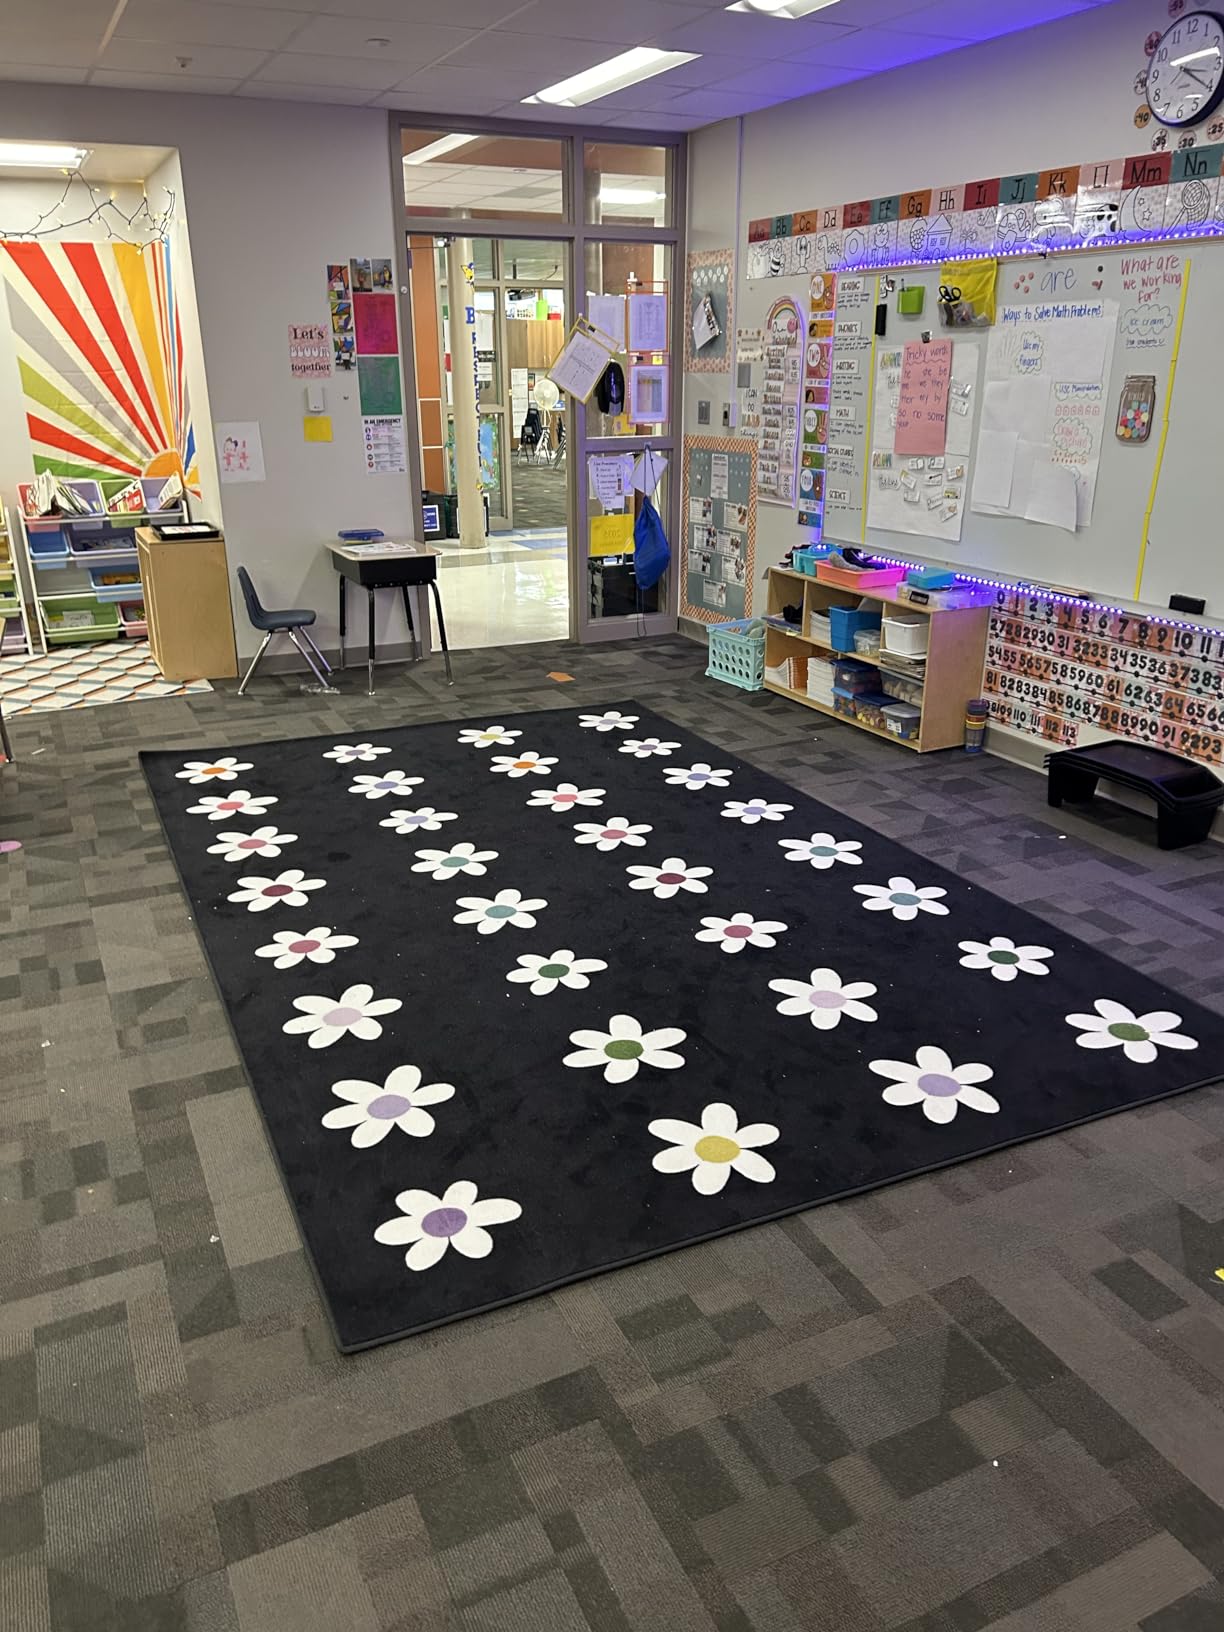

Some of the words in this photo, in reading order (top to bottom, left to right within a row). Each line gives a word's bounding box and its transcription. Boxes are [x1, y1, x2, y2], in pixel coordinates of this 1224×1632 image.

[1187, 18, 1199, 34] 12
[1203, 22, 1209, 37] 1
[1171, 30, 1182, 45] 11
[1213, 35, 1220, 48] 2
[1156, 47, 1168, 63] 10
[1214, 57, 1222, 71] 3
[1151, 69, 1159, 84] 9
[1206, 78, 1214, 92] 4
[1153, 88, 1161, 102] 8
[1162, 102, 1170, 117] 7
[1176, 104, 1183, 118] 6
[1191, 97, 1199, 111] 5
[1131, 161, 1162, 183] Mm
[1184, 152, 1208, 176] Nn
[1011, 179, 1026, 203] Jj
[1048, 172, 1067, 195] Kk
[938, 190, 955, 211] Hh
[975, 185, 986, 205] Ii
[879, 200, 892, 220] Ff
[907, 196, 923, 217] Gg
[799, 216, 810, 231] Cc
[823, 210, 836, 228] Dd
[850, 210, 862, 225] Ee
[776, 221, 787, 235] Bb
[1121, 257, 1153, 275] What
[1158, 254, 1179, 269] are
[1040, 268, 1076, 294] are
[1123, 279, 1137, 290] we
[1141, 272, 1182, 290] working
[1138, 288, 1160, 303] for?
[1002, 307, 1021, 326] Ways
[1024, 307, 1032, 320] to
[1034, 305, 1051, 321] Solve
[1052, 304, 1070, 318] Math
[293, 327, 325, 341] Let's
[906, 347, 928, 362] Tricky
[291, 361, 331, 373] together
[836, 408, 850, 418] MATH
[997, 589, 1005, 604] 0
[1014, 593, 1019, 610] 1
[1029, 597, 1038, 612] 2
[1045, 601, 1054, 617] 3
[1063, 604, 1073, 622] 4
[1081, 608, 1090, 625] 5
[1098, 612, 1108, 629] 6
[1119, 618, 1129, 634] 7
[1139, 622, 1149, 640] 8
[1157, 627, 1168, 643] 9
[1174, 630, 1193, 650] 10
[1200, 636, 1212, 655] 11
[991, 618, 1006, 632] 27
[1006, 621, 1022, 637] 28
[1023, 625, 1038, 641] 29
[1038, 629, 1055, 645] 30
[1057, 634, 1070, 650] 31
[1073, 638, 1091, 656] 32
[1091, 642, 1109, 660] 33
[1110, 647, 1128, 665] 34
[1130, 652, 1148, 669] 35
[1148, 657, 1167, 675] 36
[1169, 663, 1190, 681] 37
[1190, 668, 1213, 688] 38
[988, 645, 1002, 660] 54
[1003, 650, 1017, 664] 55
[1019, 654, 1034, 670] 56
[1035, 657, 1052, 674] 57
[1052, 661, 1068, 679] 58
[1069, 666, 1085, 683] 59
[1086, 671, 1104, 688] 60
[1107, 678, 1120, 694] 61
[1124, 682, 1143, 700] 62
[1144, 689, 1163, 707] 63
[1165, 696, 1184, 714] 64
[1186, 701, 1206, 719] 65
[986, 671, 997, 686] 81
[1000, 675, 1015, 691] 82
[1016, 679, 1031, 696] 83
[1032, 684, 1047, 702] 84
[1049, 689, 1064, 706] 85
[1066, 694, 1082, 712] 86
[1083, 700, 1101, 718] 87
[1100, 705, 1119, 724] 88
[1120, 711, 1138, 730] 89
[1139, 717, 1159, 736] 90
[1162, 724, 1176, 743] 91
[1180, 729, 1201, 750] 92
[1201, 733, 1222, 755] 93
[1013, 707, 1026, 722] 110
[1045, 717, 1058, 733] 112
[1062, 723, 1076, 739] 113
